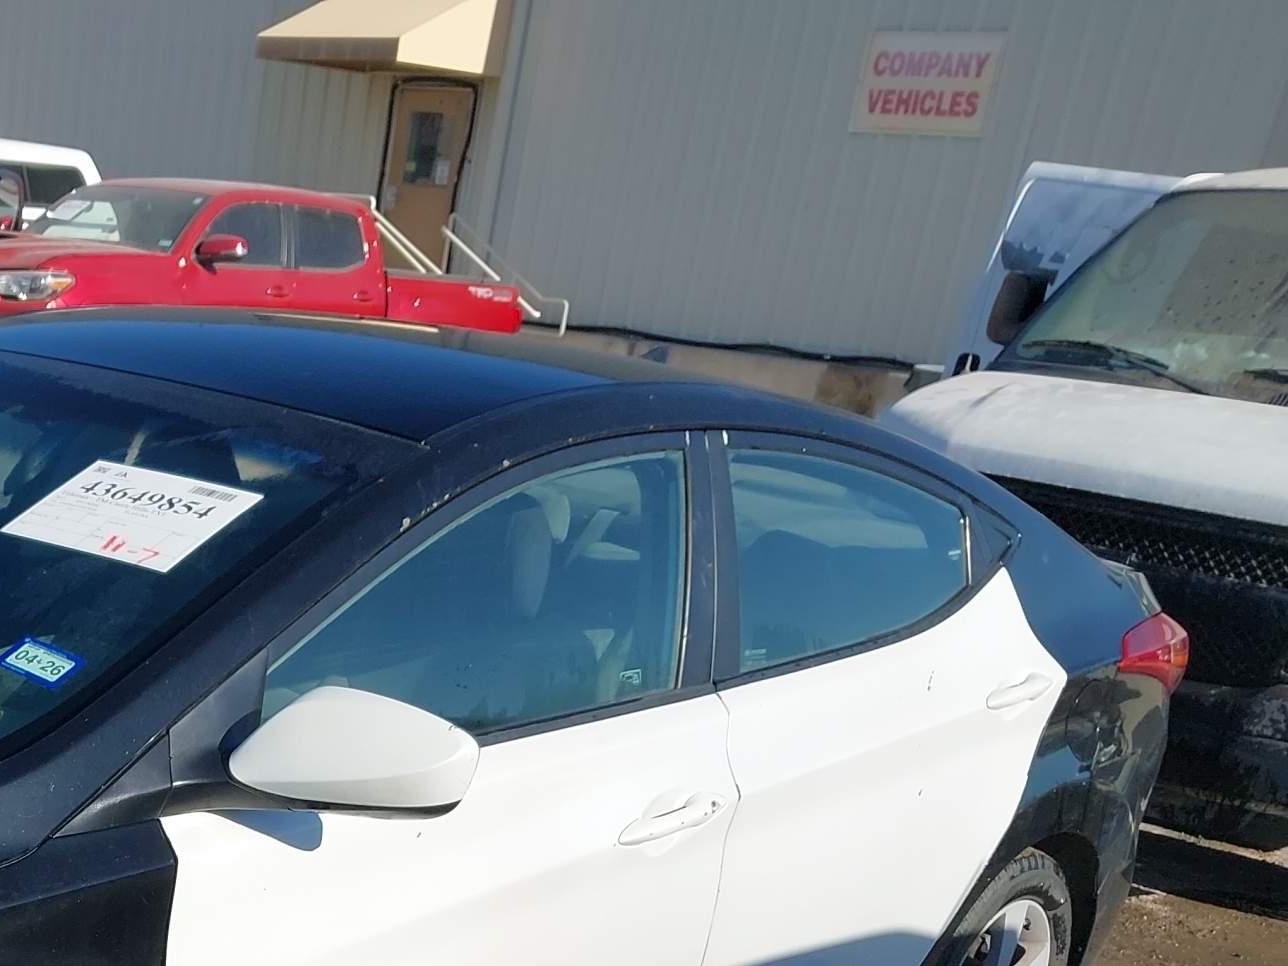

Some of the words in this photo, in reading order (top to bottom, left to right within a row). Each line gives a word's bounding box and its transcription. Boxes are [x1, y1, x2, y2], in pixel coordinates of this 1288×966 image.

[872, 51, 991, 78] COMPANY
[867, 88, 980, 118] VEHICLES
[79, 480, 217, 519] 43649854
